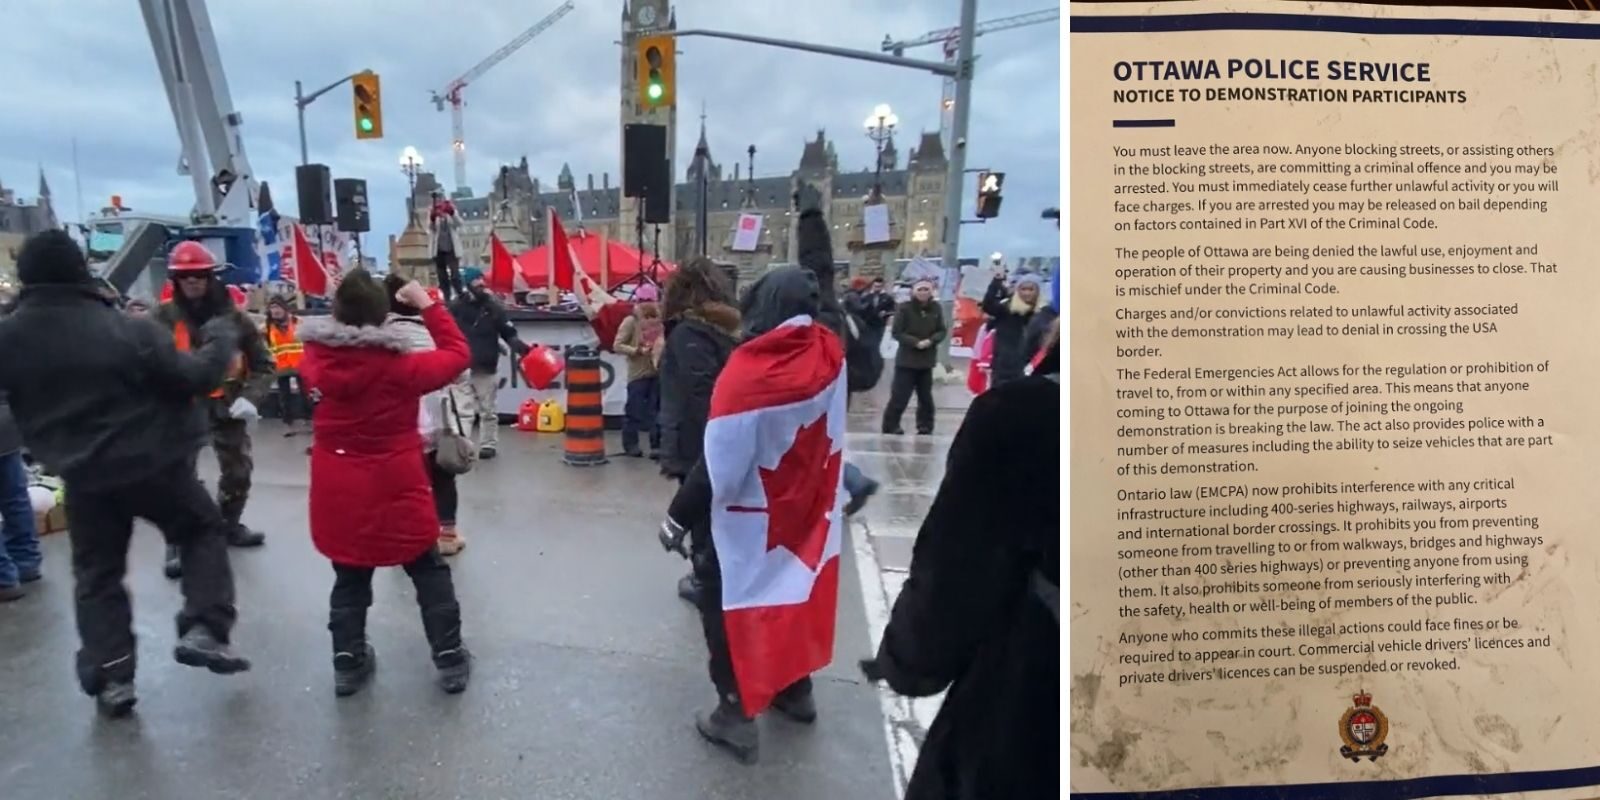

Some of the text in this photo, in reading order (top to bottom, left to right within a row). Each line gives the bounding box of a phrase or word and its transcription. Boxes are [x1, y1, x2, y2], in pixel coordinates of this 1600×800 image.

[1113, 58, 1431, 83] OTTAWA POLICE SERVICE
[1113, 86, 1467, 104] NOTICE TO DEMONSTRATION PARTICIPANTS
[1112, 143, 1555, 159] You must leave the area now. Anyone blocking streets, or assisting others
[1113, 161, 1558, 177] in the blocking streets, are committing a criminal offence and you may be
[1114, 179, 1559, 195] arrested. You must immediately cease further unlawful activity or you will
[1114, 198, 1548, 215] face charges. If you are arrested you may be released on bail depending
[1114, 216, 1438, 232] on factors contained in Part XVI of the Criminal Code.
[1115, 282, 1340, 297] is mischief under the Criminal Code.
[1115, 302, 1518, 323] Charges and/or convictions related to unlawful activity associated
[1116, 345, 1162, 358] border.
[1116, 359, 1550, 382] The Federal Emergencies Act allows for the regulation or prohibition of
[1116, 415, 1545, 438] demonstration is breaking the law. The act also provides police with a
[1116, 460, 1259, 476] of this demonstration.
[1117, 477, 1515, 502] Ontario law (EMCPA) now prohibits interference with any critical
[1117, 497, 1508, 521] infrastructure including 400-series highways, railways, airports
[1117, 514, 1540, 540] and international border crossings. It prohibits you from preventing
[1118, 592, 1478, 621] the safety, health or well-being of members of the public.
[1118, 616, 1519, 647] Anyone who commits these illegal actions could face fines or be
